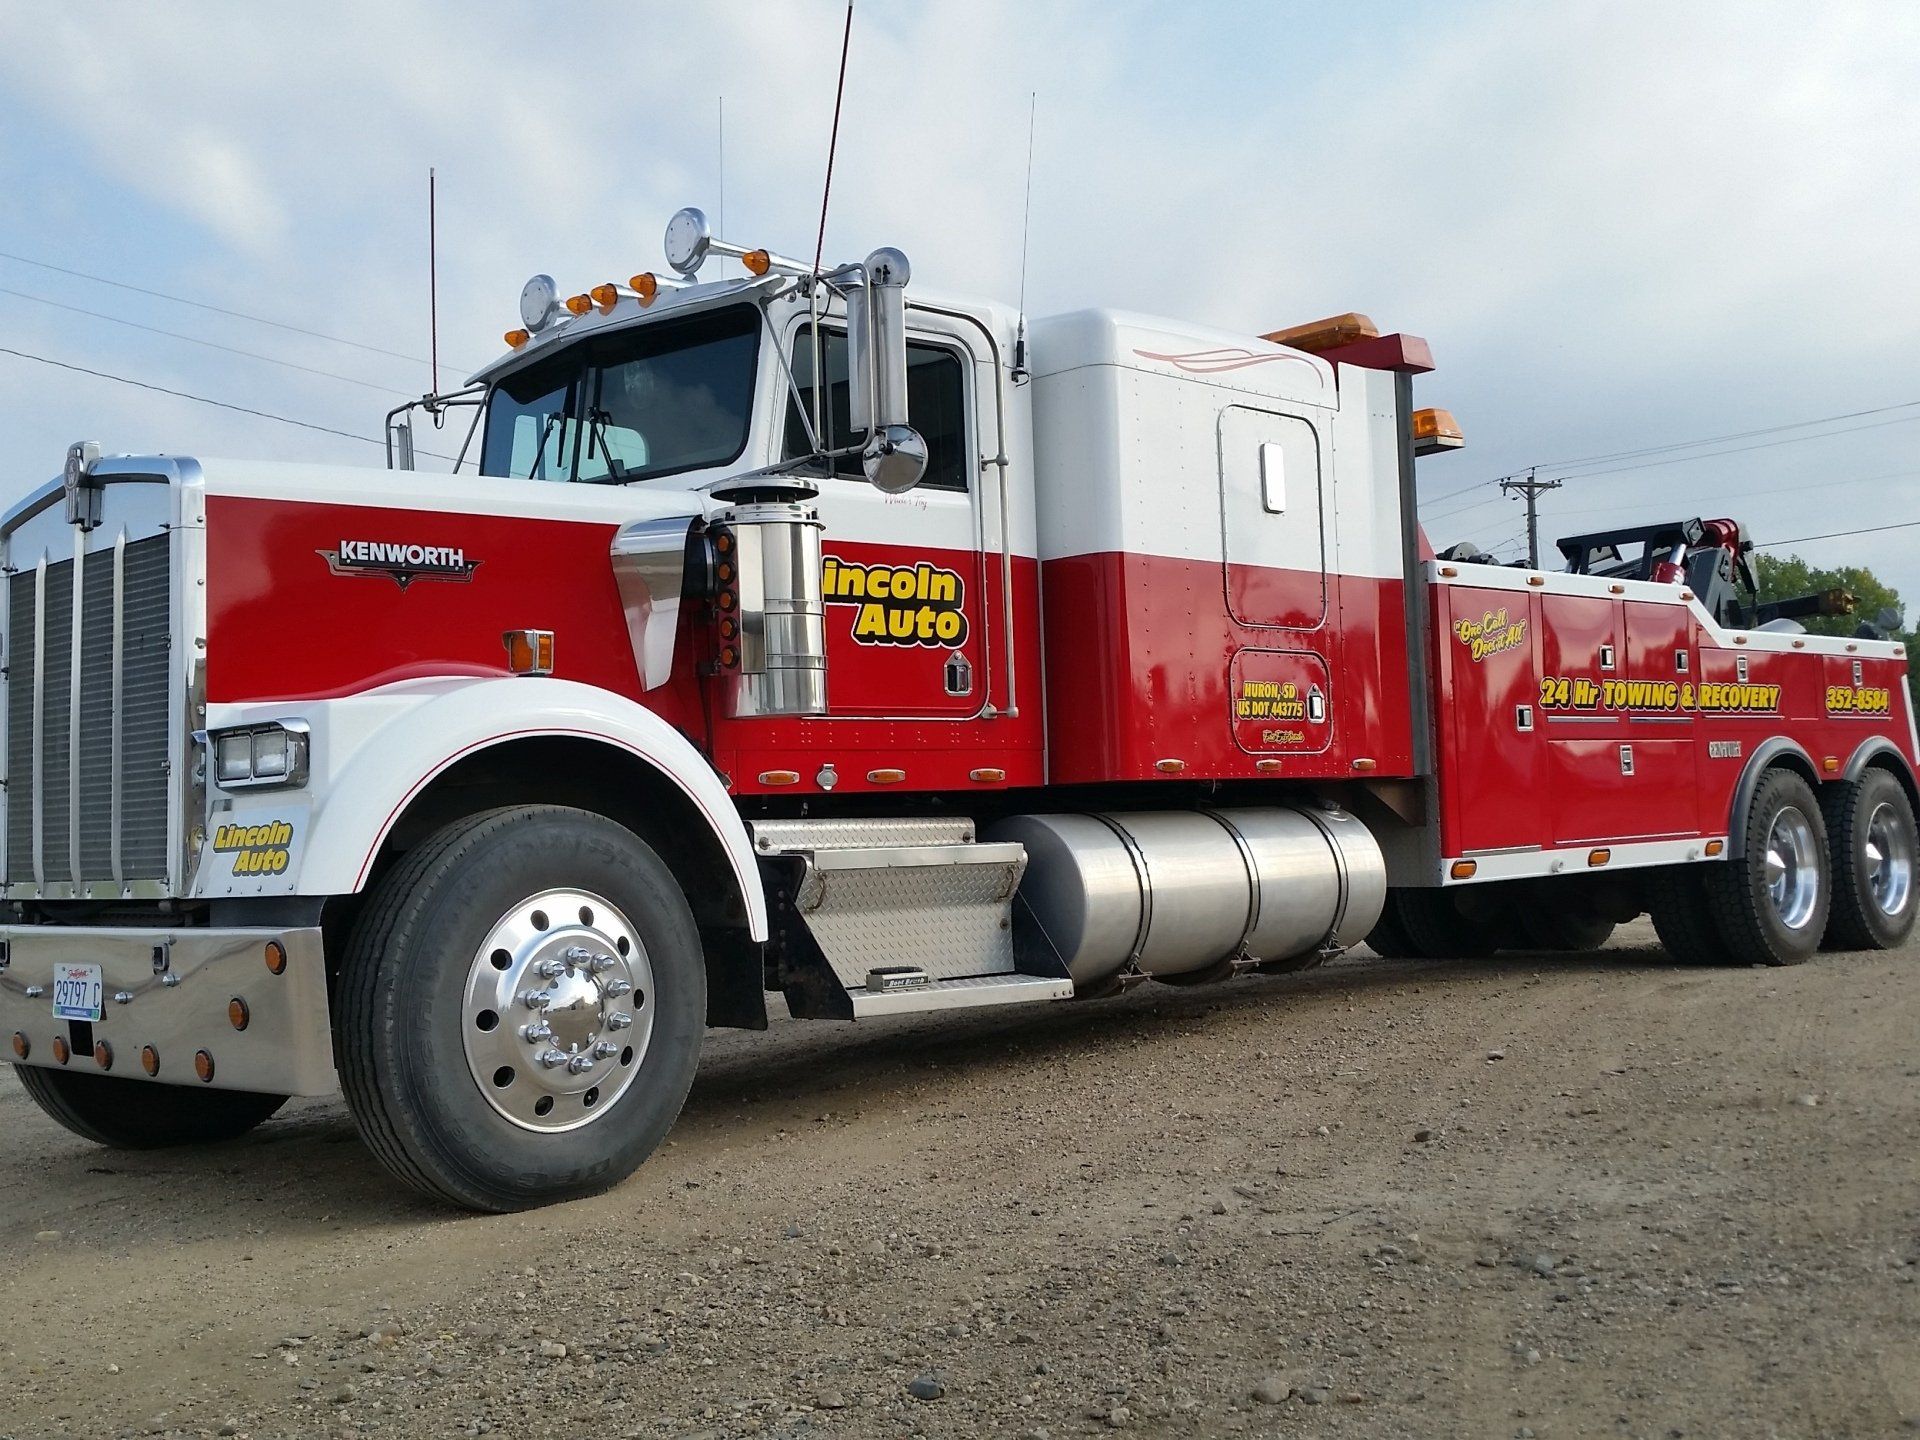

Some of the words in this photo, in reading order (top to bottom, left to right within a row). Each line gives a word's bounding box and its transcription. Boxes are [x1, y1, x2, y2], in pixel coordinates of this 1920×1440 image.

[340, 540, 464, 567] KENWORTH
[822, 560, 958, 602] incoln
[856, 603, 962, 640] Auto
[1484, 610, 1507, 634] Call
[1473, 638, 1497, 659] Does
[1244, 682, 1281, 700] HURON,
[1283, 684, 1297, 699] SD
[1540, 679, 1570, 706] 24
[1574, 680, 1600, 707] Hr
[1603, 681, 1677, 709] TOWING
[1681, 684, 1696, 709] &
[1700, 684, 1780, 710] RECOVERY
[1827, 688, 1888, 711] 352-8584
[1239, 701, 1251, 716] US
[1252, 701, 1270, 716] DOT
[1271, 702, 1304, 717] 443775
[214, 821, 292, 849] Lincoln
[232, 848, 289, 874] Auto
[56, 980, 87, 1006] 29797
[93, 983, 100, 1008] C
